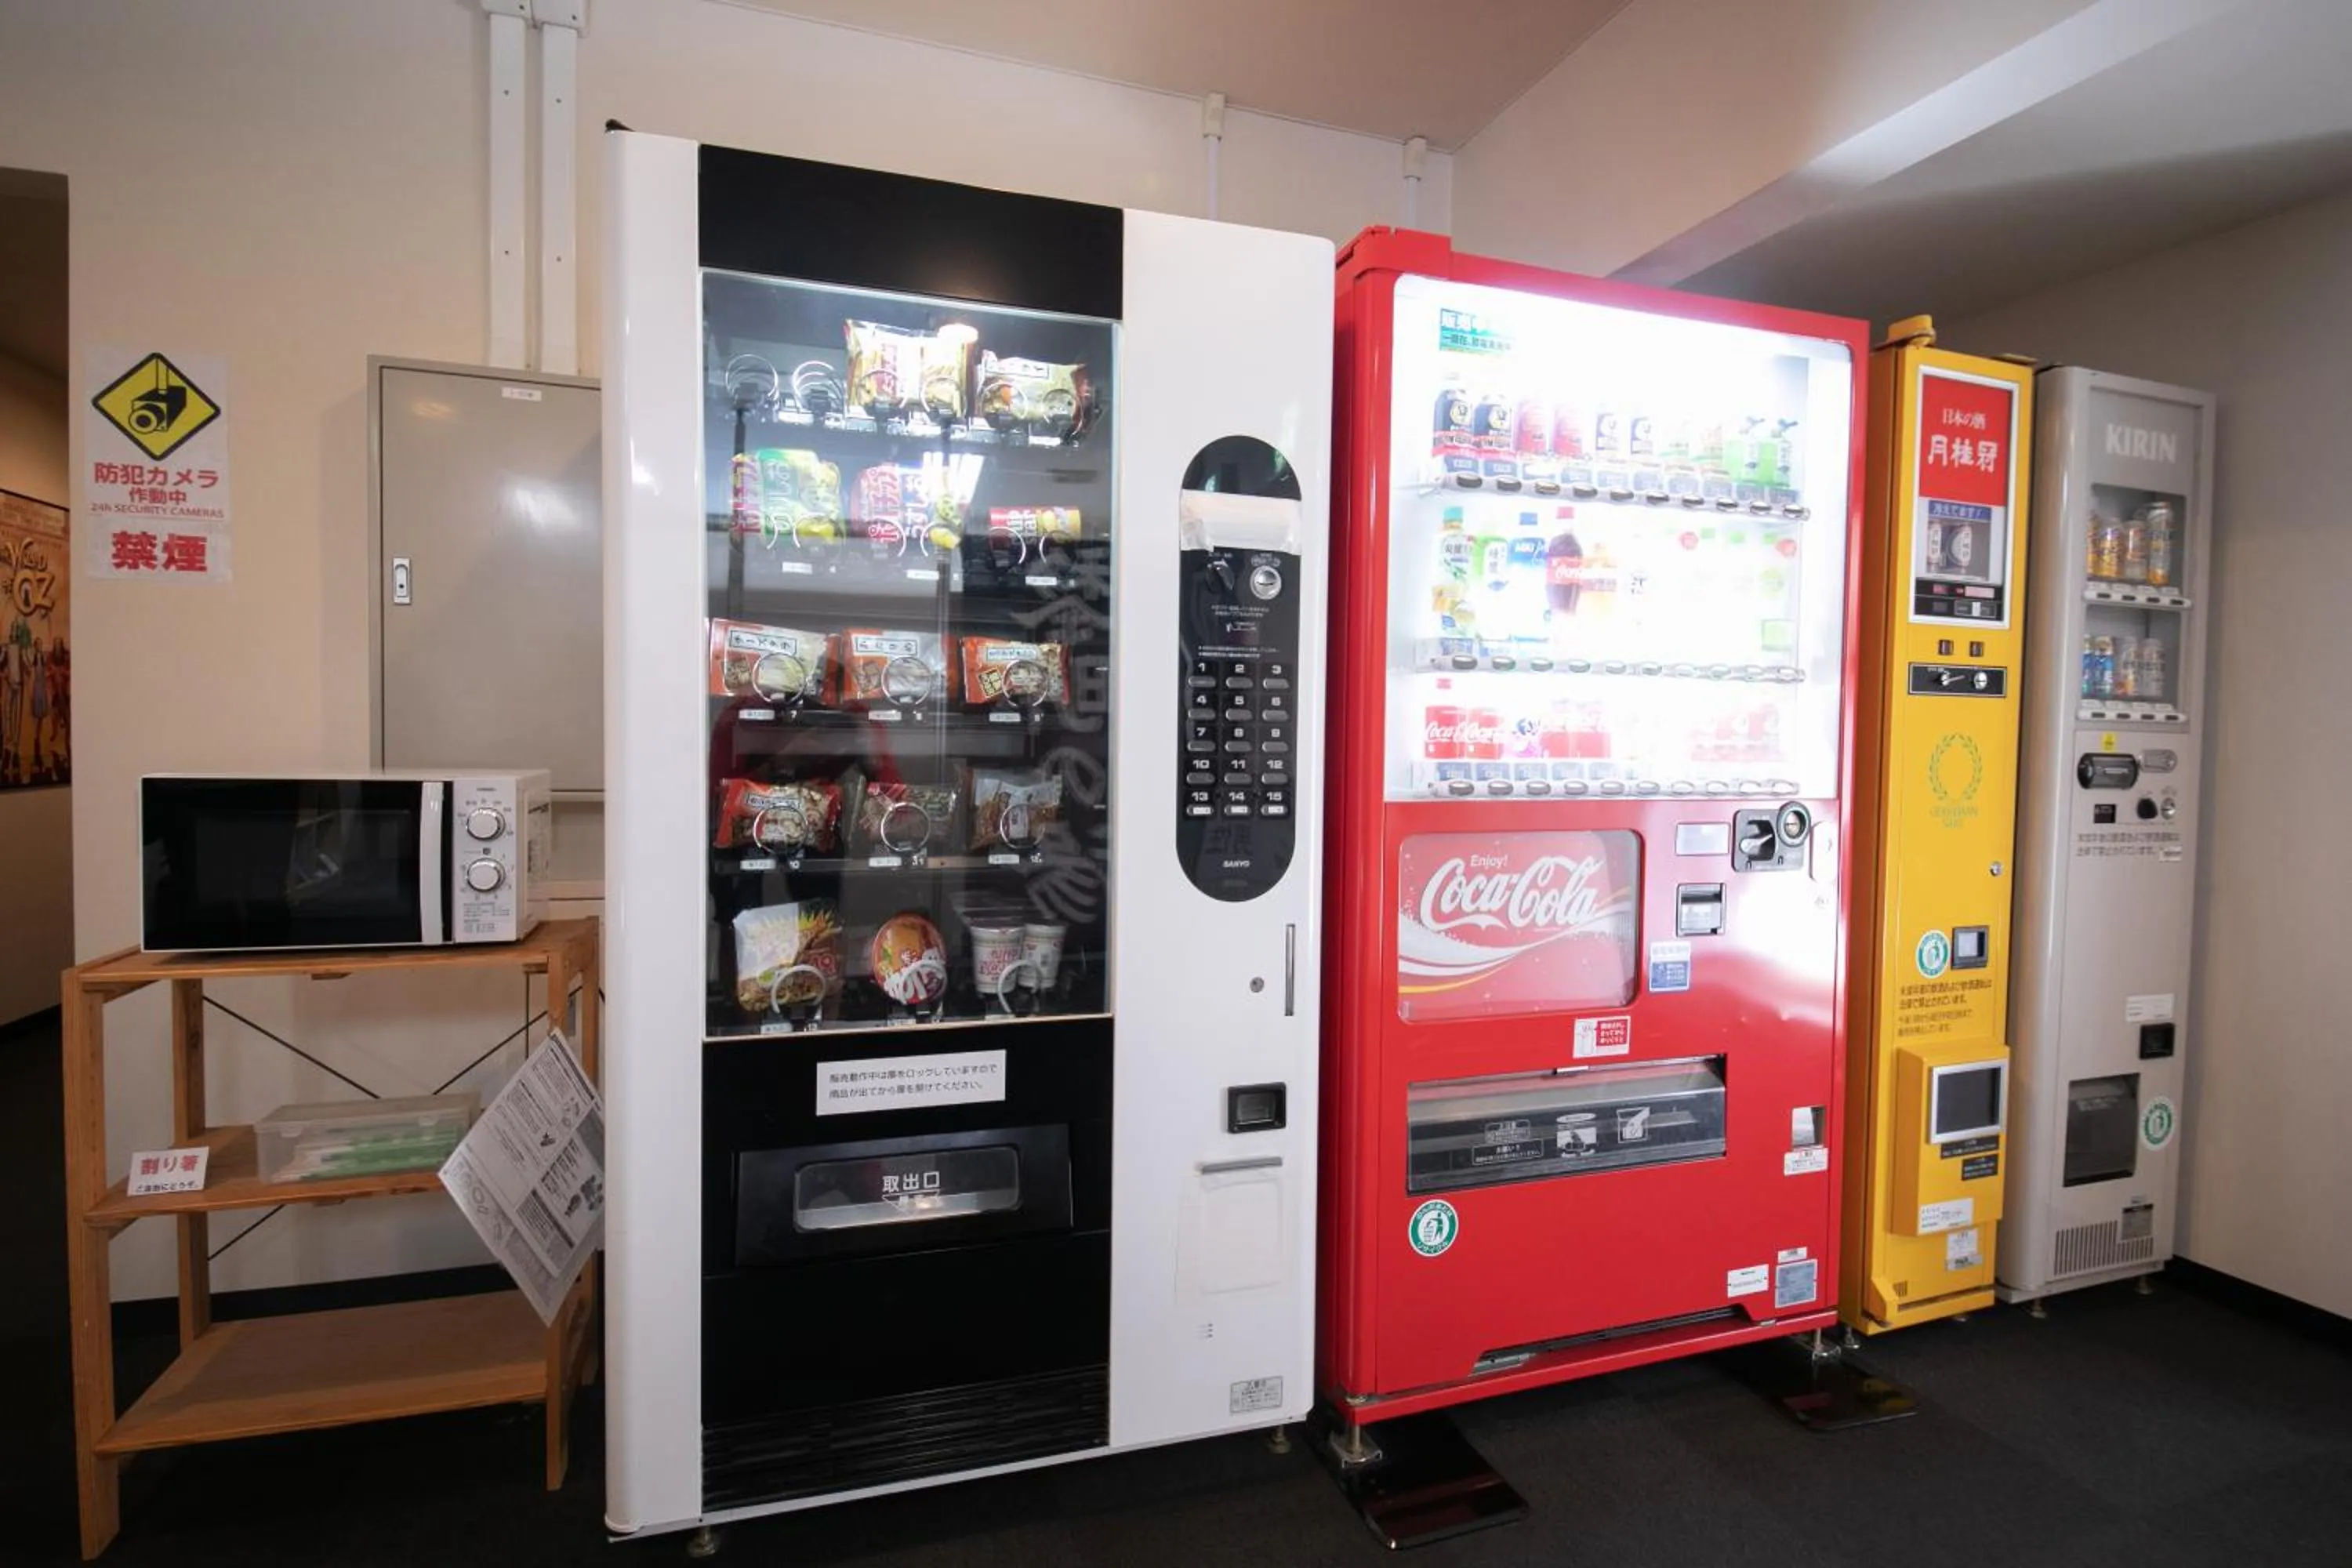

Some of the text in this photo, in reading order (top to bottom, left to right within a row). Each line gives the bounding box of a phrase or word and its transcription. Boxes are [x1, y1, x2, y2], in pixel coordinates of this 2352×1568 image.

[2106, 423, 2176, 464] KIRIN
[1928, 434, 1998, 473] 月桂冠
[93, 462, 219, 488] 防犯カメラ
[129, 487, 187, 506] 作動中
[114, 504, 167, 516] SECURITY
[170, 506, 225, 519] CAMERAS
[111, 530, 208, 572] 禁煙
[1198, 662, 1282, 674] 1 2 3
[1196, 695, 1207, 705] 4
[1235, 695, 1244, 705] 5
[1196, 727, 1206, 736] 7
[1193, 760, 1283, 769] 10 11 12
[1192, 792, 1283, 801] 13 14 15
[1222, 859, 1250, 868] SANYO
[1470, 854, 1508, 869] Enjoy!
[1420, 855, 1605, 932] Coca-Cola
[882, 1171, 940, 1193] 取出口
